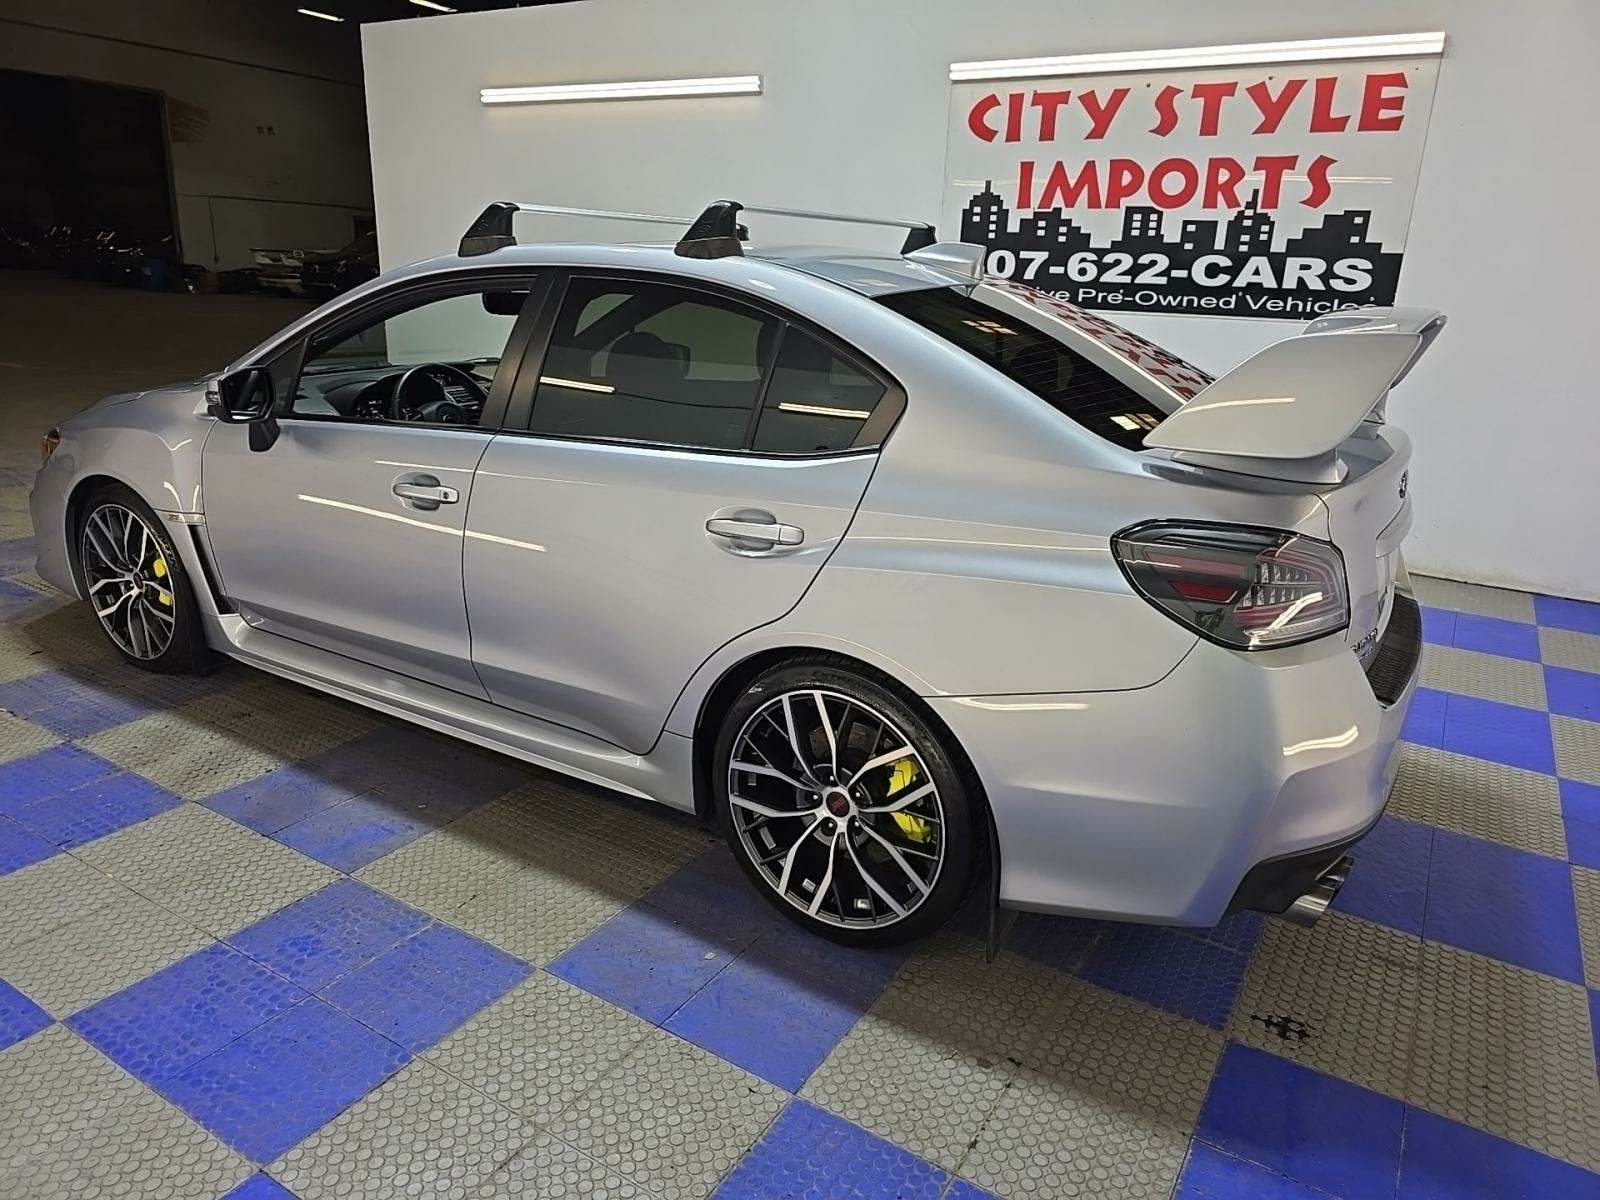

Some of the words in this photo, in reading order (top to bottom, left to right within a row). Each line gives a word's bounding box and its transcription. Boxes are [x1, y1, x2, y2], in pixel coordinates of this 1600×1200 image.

[967, 87, 1132, 143] CITY
[1147, 71, 1409, 138] STYLE
[1015, 153, 1339, 210] IMPORTS
[986, 249, 1374, 292] 07-622-CARS
[1077, 288, 1237, 310] Pre-Owned
